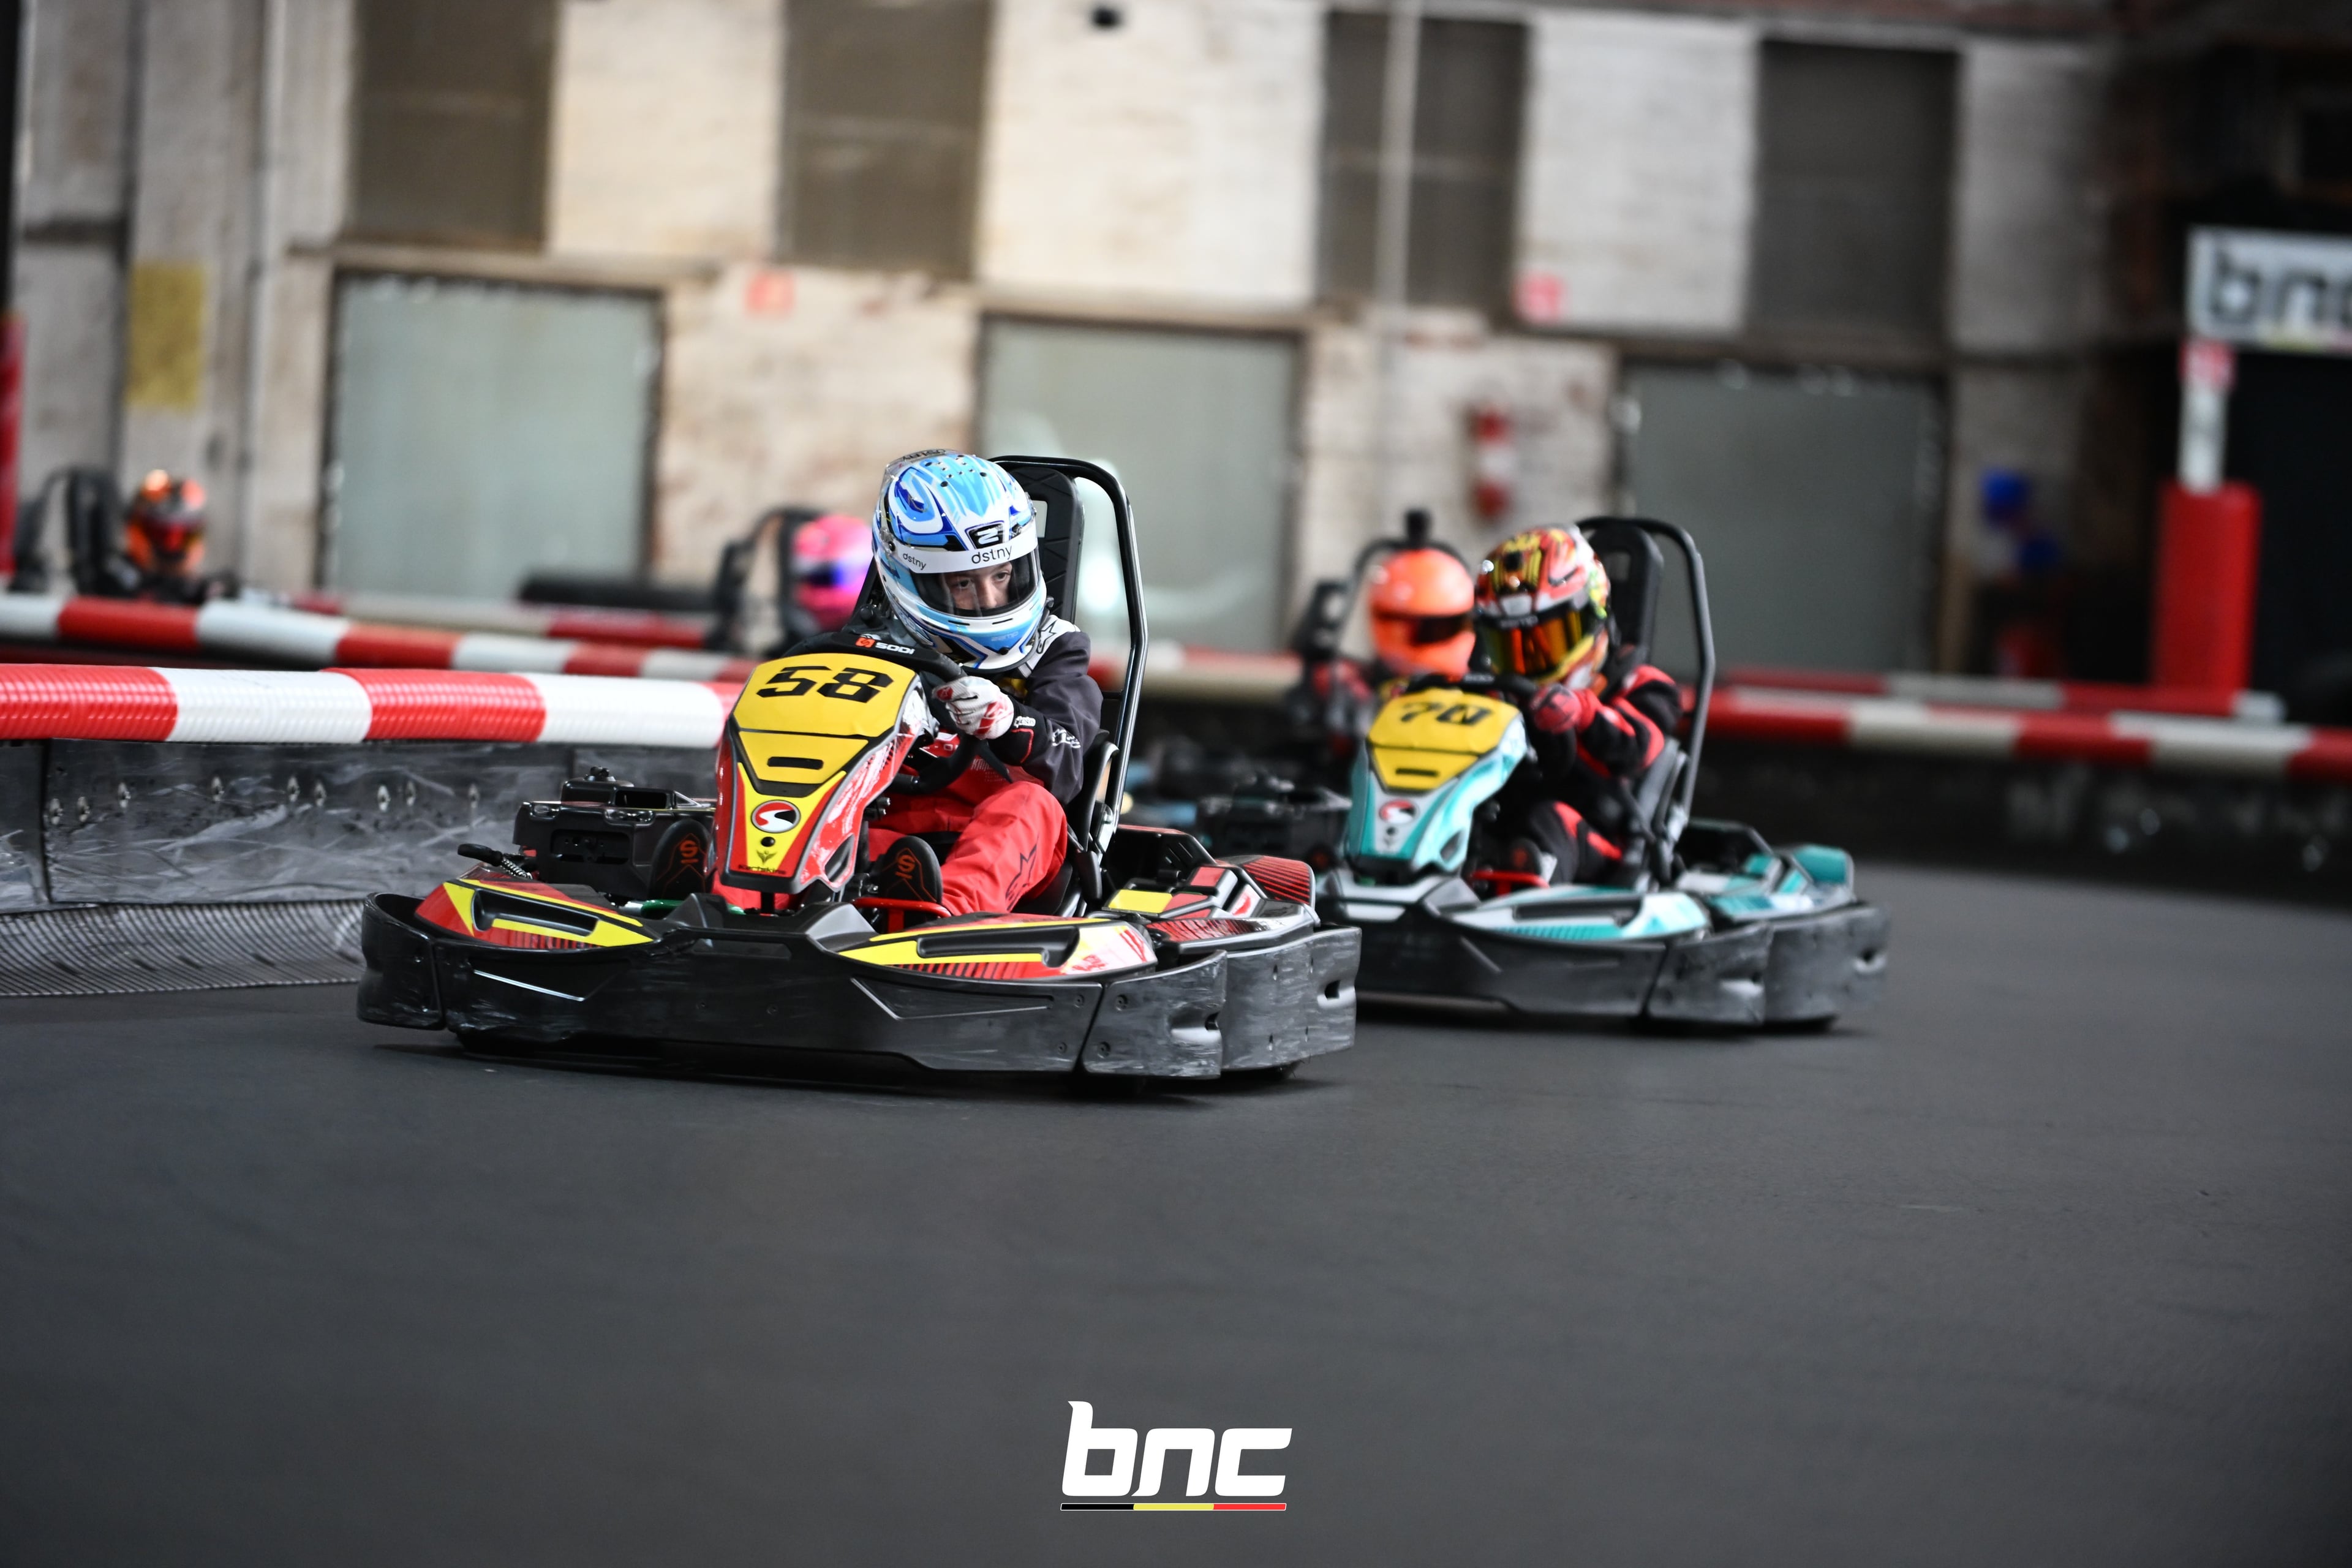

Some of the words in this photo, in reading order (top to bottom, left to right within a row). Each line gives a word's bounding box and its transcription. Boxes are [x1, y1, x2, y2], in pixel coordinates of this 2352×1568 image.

[903, 552, 927, 570] dstny
[971, 546, 1012, 564] dstny
[875, 642, 915, 655] SODI
[756, 666, 894, 703] 58
